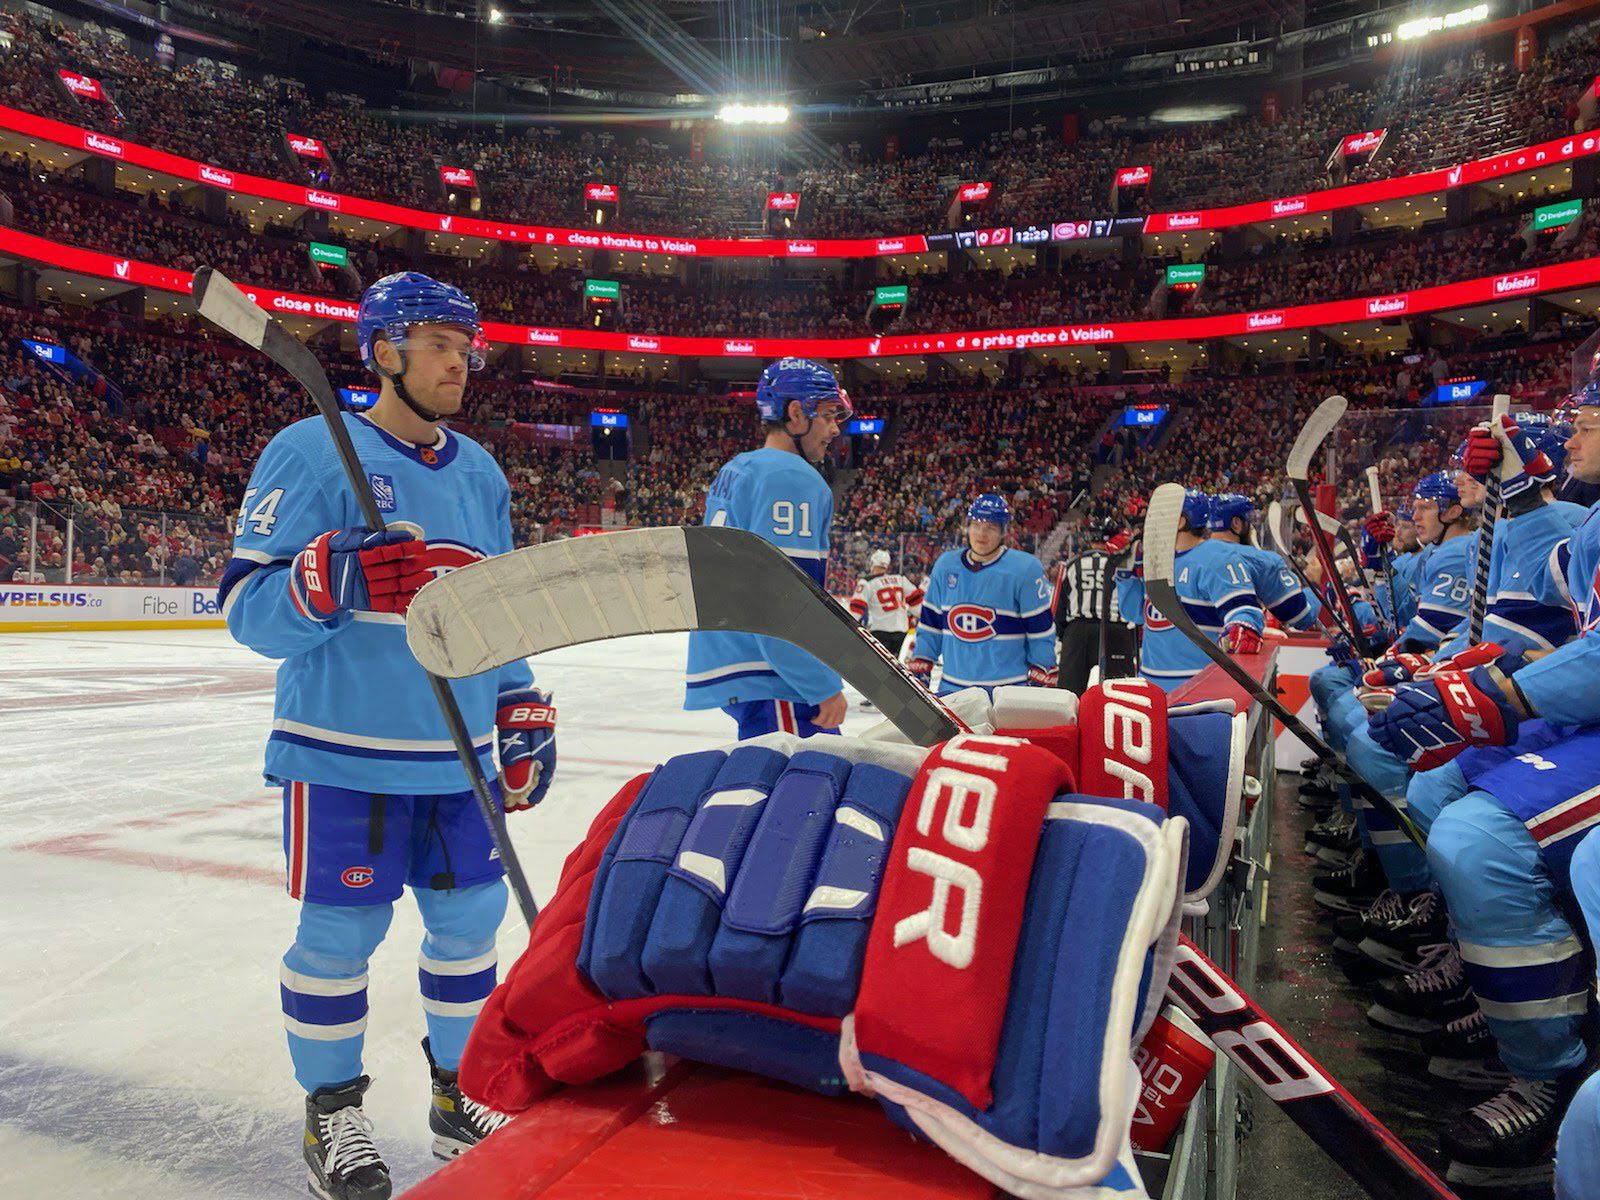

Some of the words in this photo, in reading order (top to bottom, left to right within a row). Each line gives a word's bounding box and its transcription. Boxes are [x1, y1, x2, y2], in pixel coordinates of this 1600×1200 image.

[87, 135, 121, 154] Voisin
[1349, 135, 1380, 151] Molson
[201, 168, 231, 185] Voisin
[444, 170, 471, 183] Molson
[308, 191, 338, 209] Voisin
[1273, 200, 1305, 214] Voisin
[1169, 215, 1199, 228] Voisin
[1015, 229, 1049, 243] 12:29
[1077, 224, 1088, 235] 0
[568, 233, 600, 245] close
[602, 235, 643, 249] thanks
[645, 240, 659, 249] to
[661, 240, 697, 253] Voisin
[1497, 274, 1536, 292] Voisin
[273, 296, 311, 312] close
[1369, 298, 1405, 313] Voisin
[1250, 314, 1283, 327] Voisin
[530, 330, 559, 342] Voisin
[629, 336, 658, 349] Voisin
[982, 333, 1014, 350] près
[1016, 331, 1056, 348] grâce
[1059, 330, 1069, 342] à
[1071, 327, 1114, 341] Voisin
[780, 359, 806, 370] Bell
[351, 392, 367, 403] Bell
[1452, 385, 1472, 398] Bell
[602, 414, 617, 425] Bell
[1137, 411, 1154, 423] Bell
[860, 420, 874, 432] Bell
[236, 487, 286, 537] 54
[772, 500, 813, 538] 91
[1178, 566, 1189, 584] A
[1226, 561, 1251, 585] 11
[1431, 573, 1470, 603] 28
[143, 595, 178, 615] Fibe
